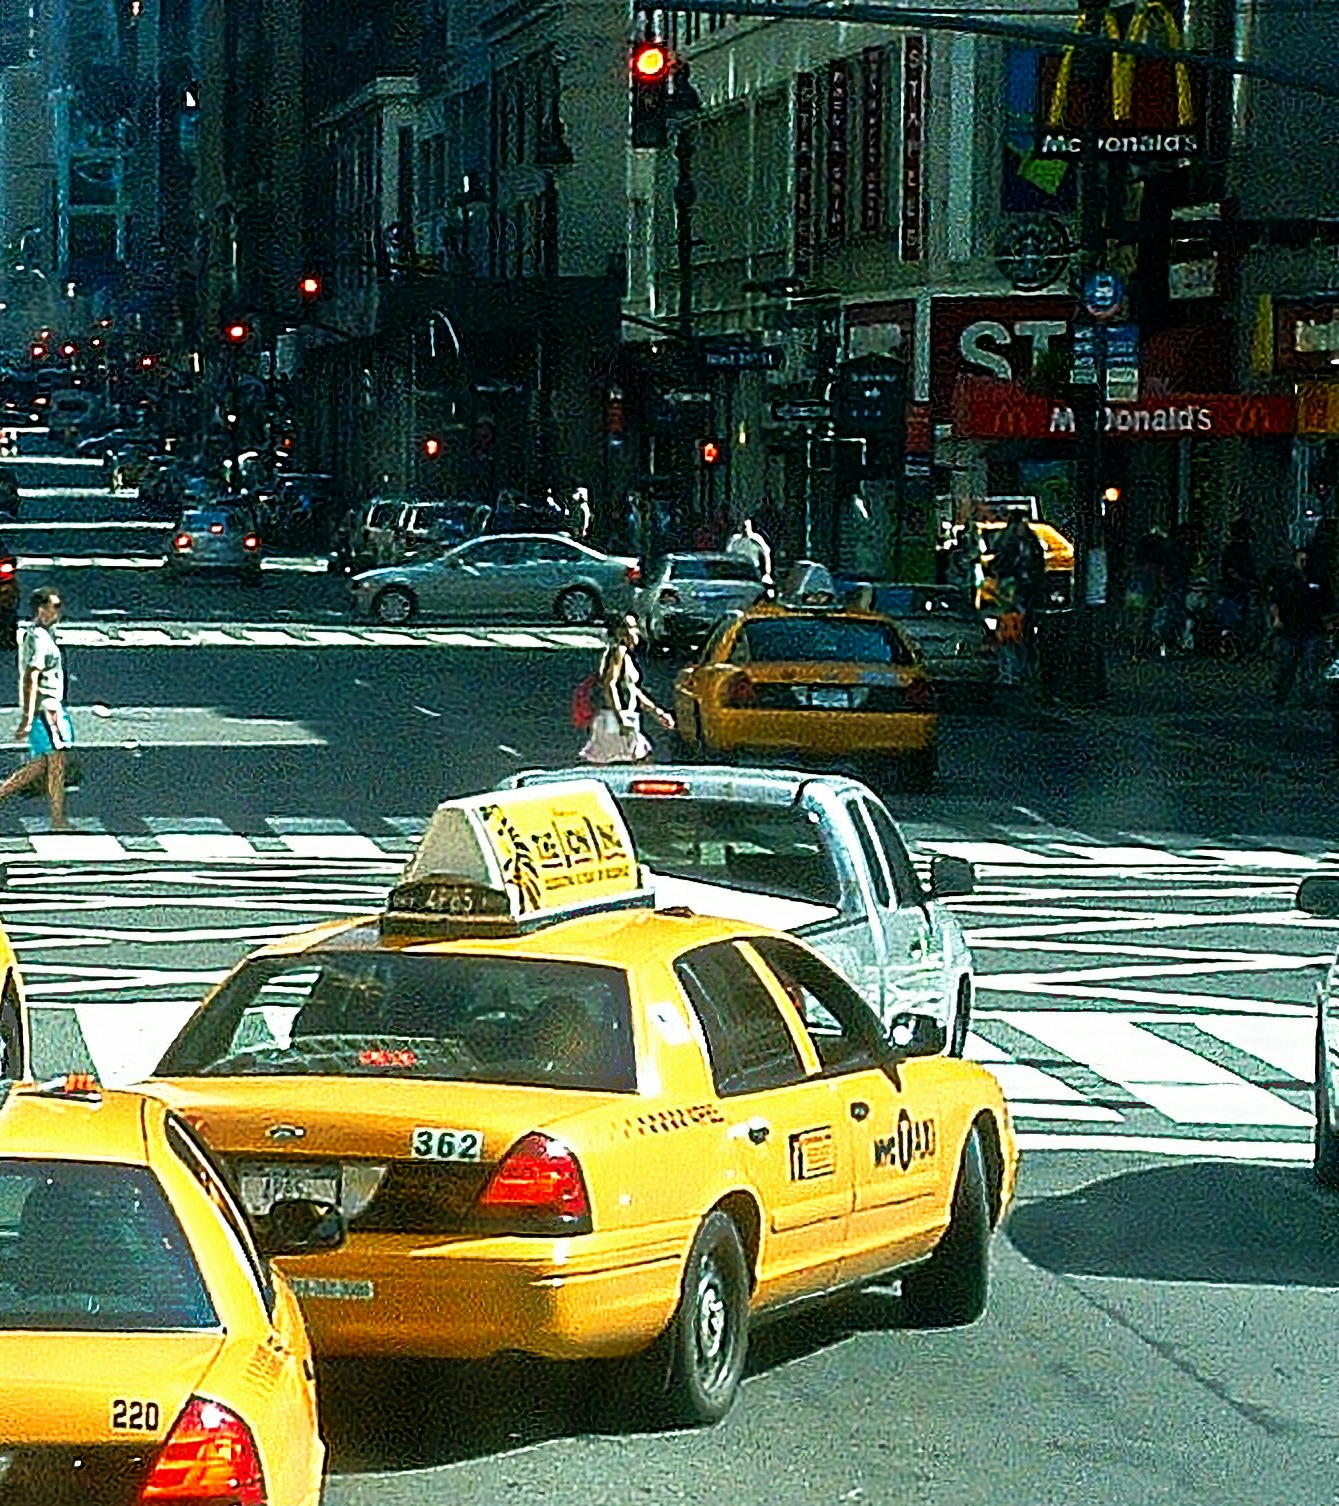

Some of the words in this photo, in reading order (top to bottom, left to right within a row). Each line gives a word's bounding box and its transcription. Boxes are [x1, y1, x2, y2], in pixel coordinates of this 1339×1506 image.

[1049, 406, 1212, 433] MDonald's
[415, 1130, 480, 1158] 362
[112, 1399, 160, 1432] 220
